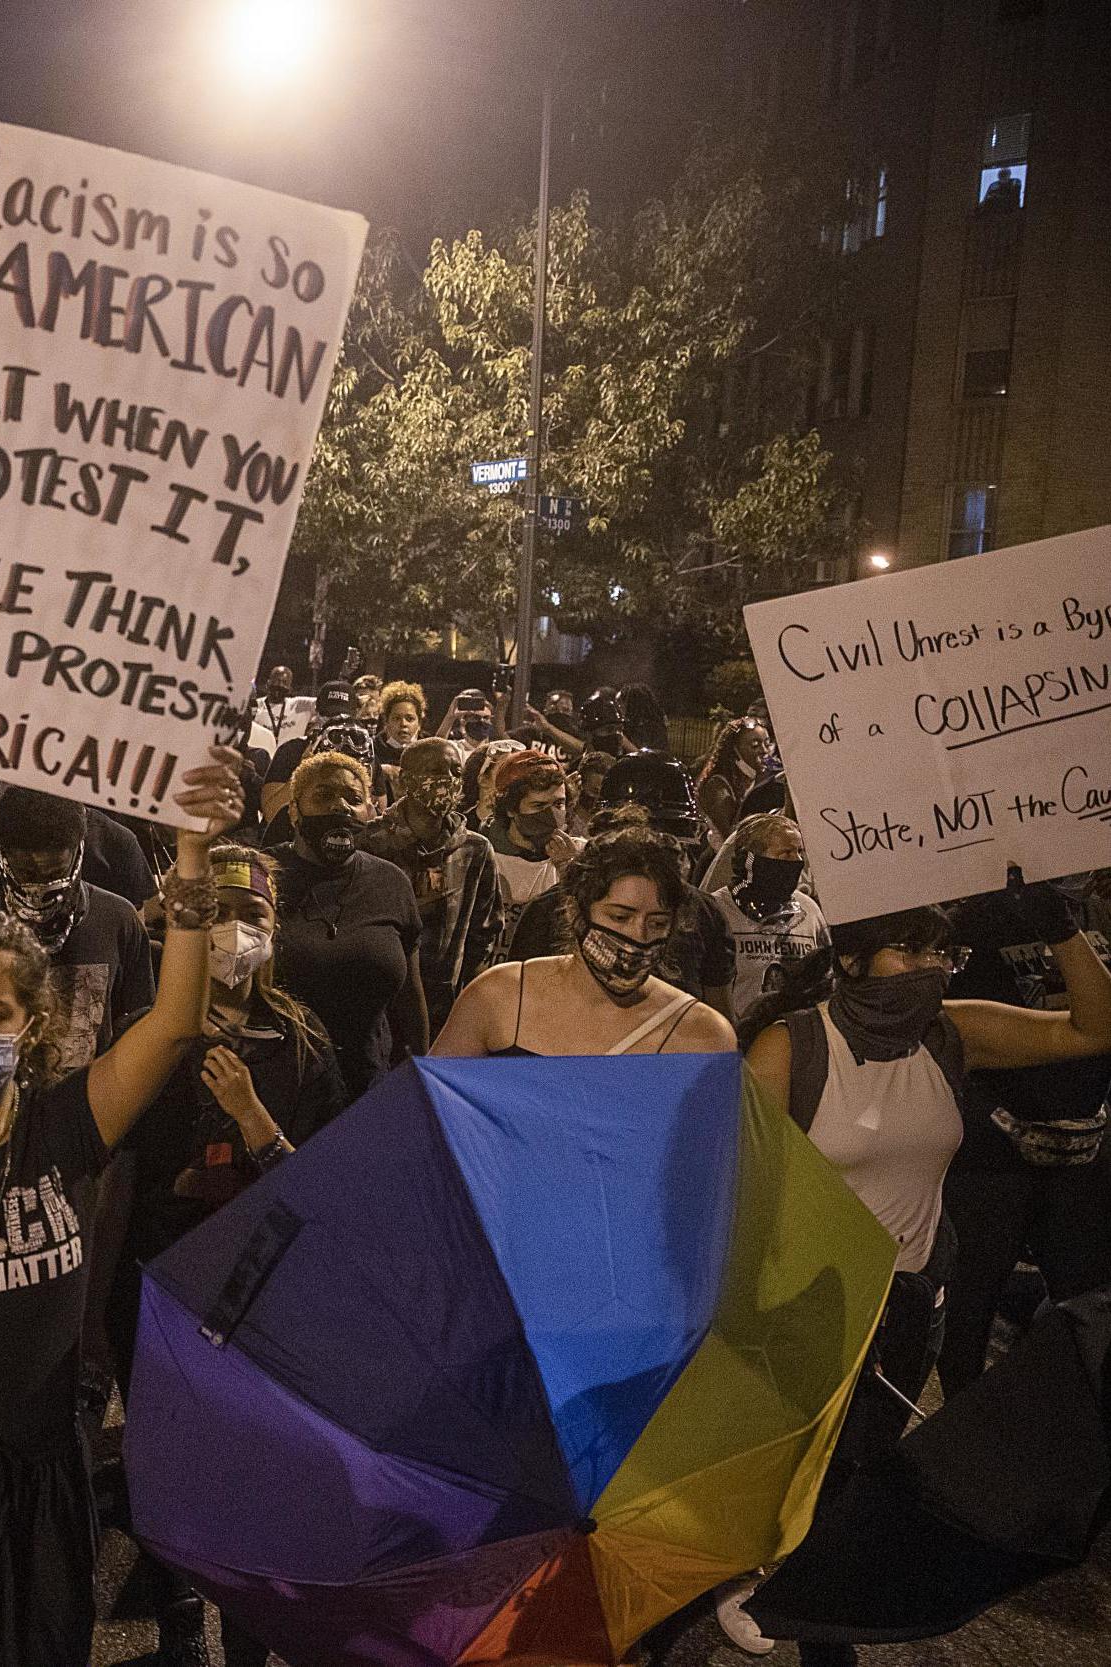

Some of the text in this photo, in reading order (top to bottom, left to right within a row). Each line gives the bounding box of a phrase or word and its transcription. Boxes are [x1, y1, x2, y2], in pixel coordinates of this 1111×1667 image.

[192, 207, 240, 268] is
[53, 382, 209, 469] WHEN
[222, 433, 300, 506] YOU
[472, 462, 517, 482] VERMONT
[489, 482, 510, 494] 1300
[550, 499, 558, 514] N
[150, 482, 265, 576] IT,
[548, 520, 570, 530] 1300
[63, 569, 235, 683] THINK
[778, 619, 883, 683] Civil
[893, 620, 984, 662] Unrest
[997, 619, 1022, 641] is
[1033, 621, 1051, 637] a
[819, 713, 842, 744] of
[868, 722, 884, 737] a
[530, 740, 570, 760] BLAC
[820, 766, 1111, 861] State, NOT the Cau
[739, 940, 813, 956] JOHN LEWIS
